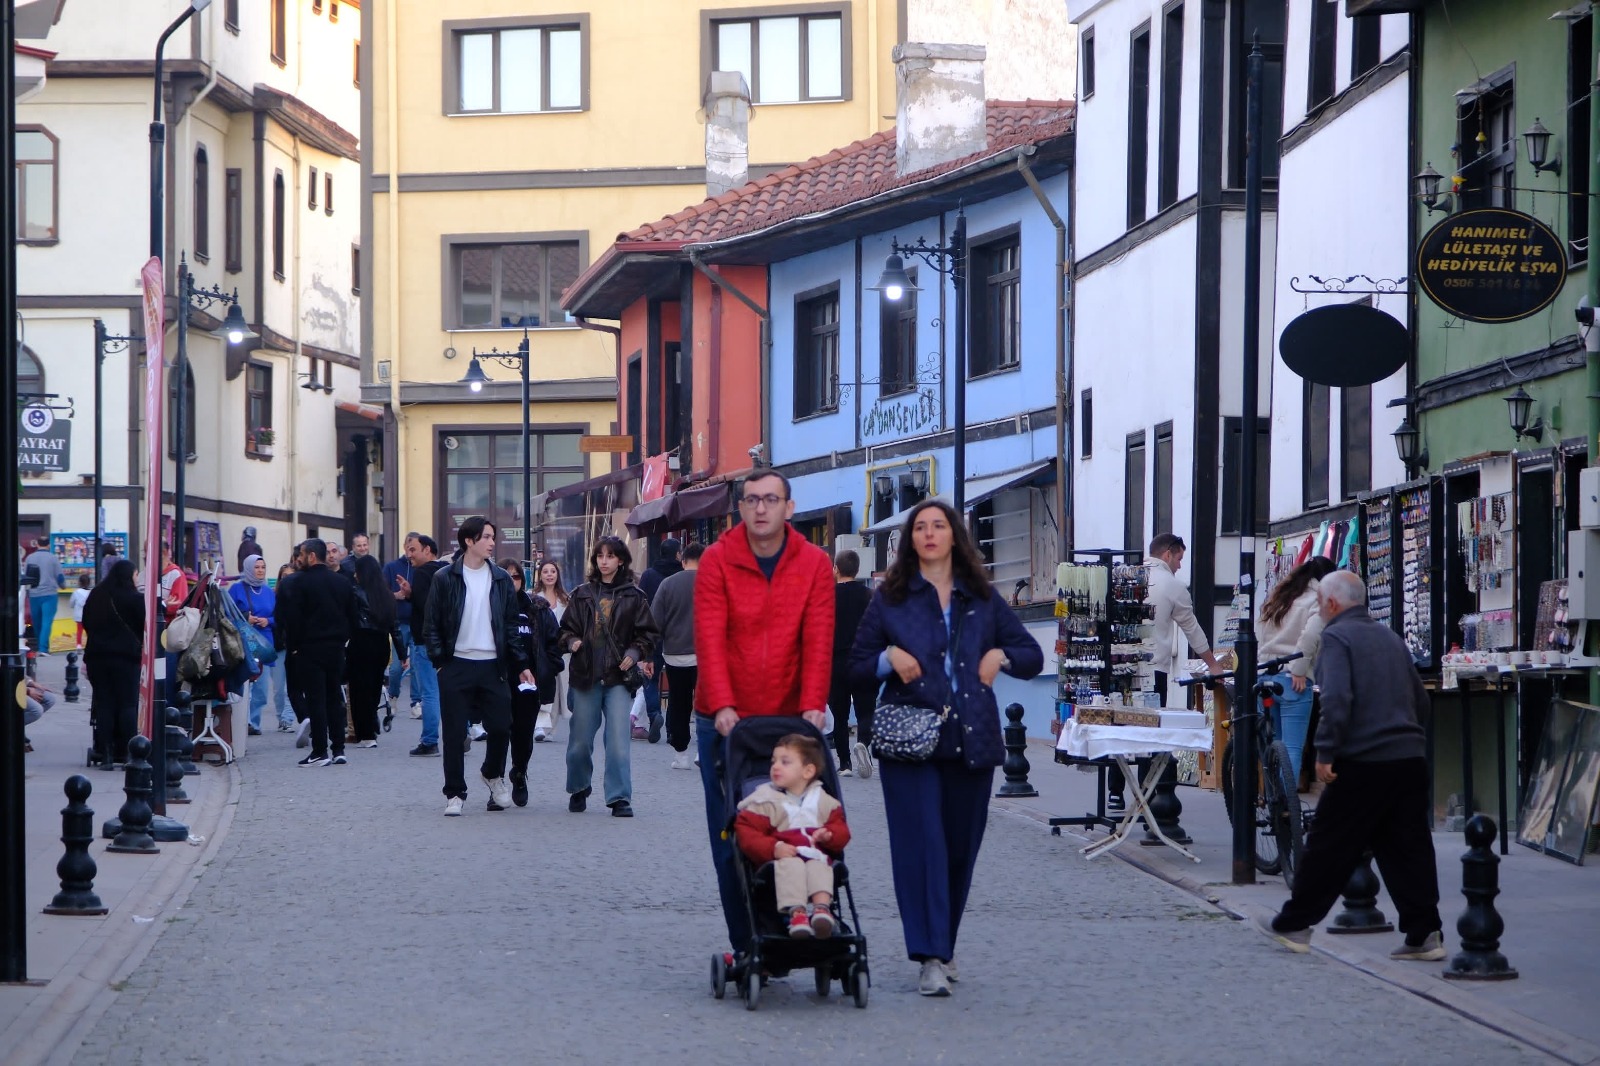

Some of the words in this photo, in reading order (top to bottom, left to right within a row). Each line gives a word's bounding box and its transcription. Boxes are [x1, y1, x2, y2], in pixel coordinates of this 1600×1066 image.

[1451, 226, 1535, 239] HANIMELİ
[1442, 242, 1517, 259] LÜLETAŞI
[1521, 245, 1544, 257] VE
[1427, 258, 1515, 272] HEDİYELİK
[1519, 261, 1558, 276] EŞYA
[18, 437, 66, 450] AYRAT
